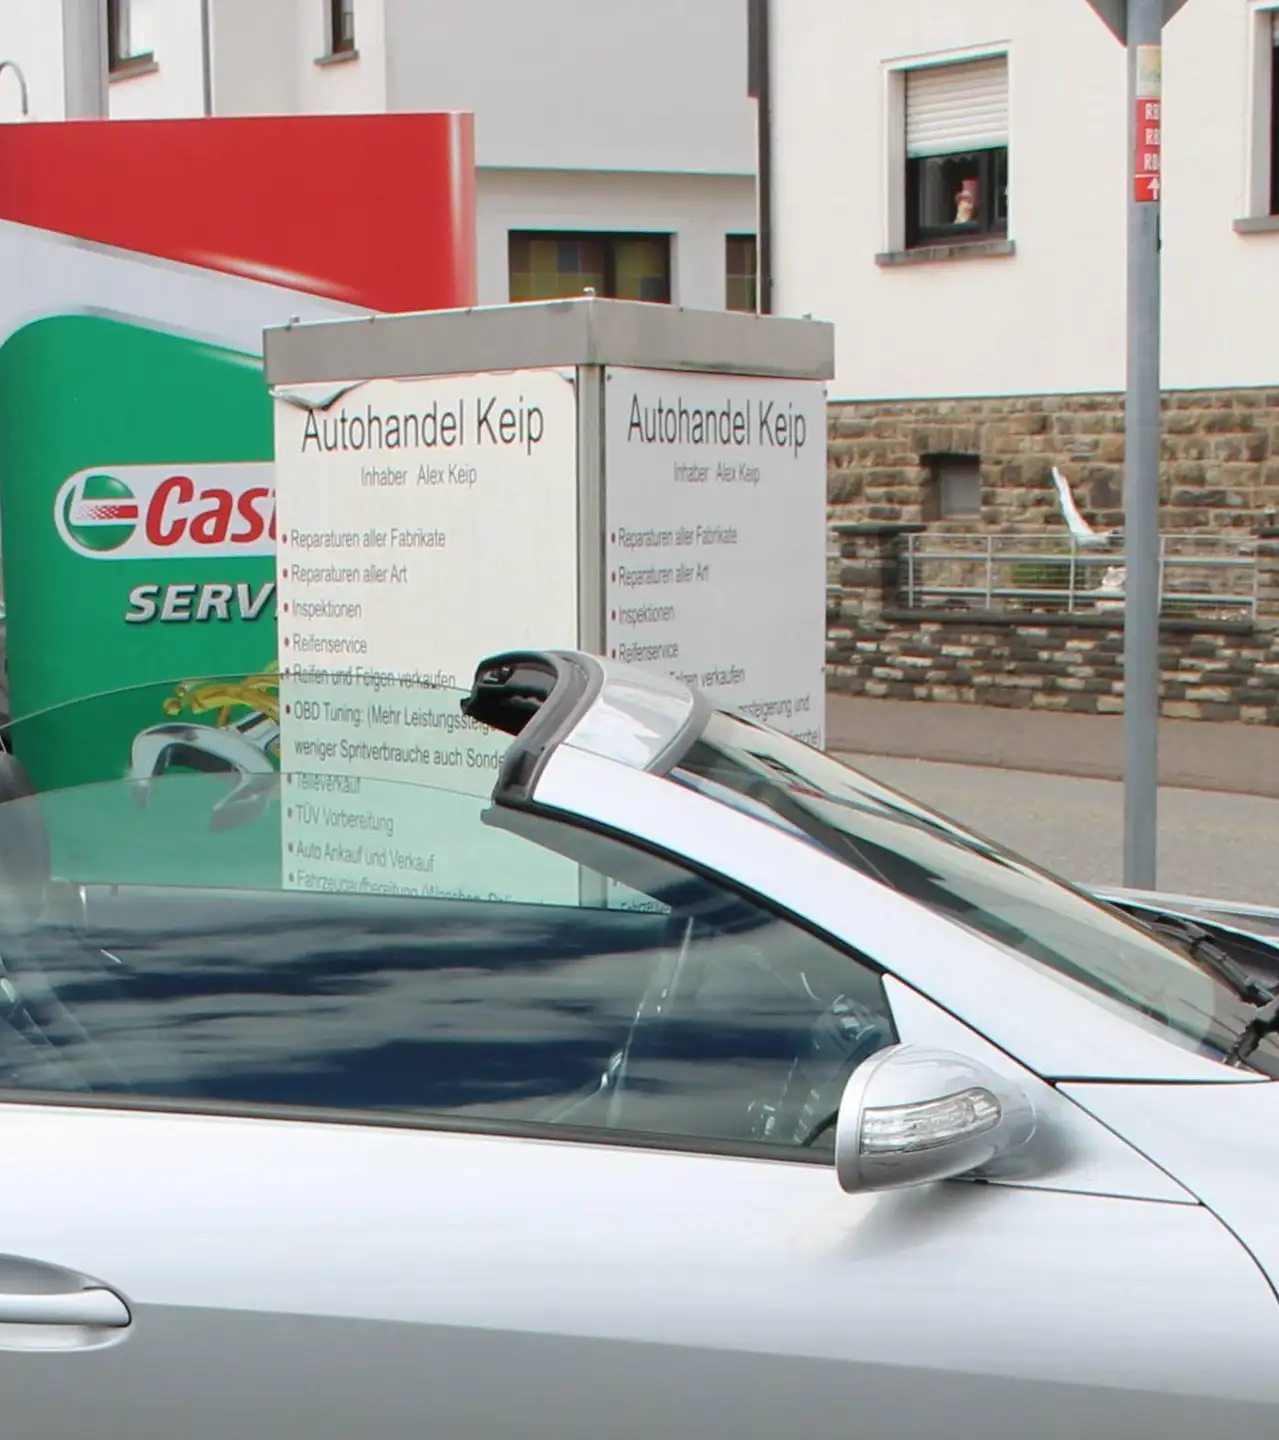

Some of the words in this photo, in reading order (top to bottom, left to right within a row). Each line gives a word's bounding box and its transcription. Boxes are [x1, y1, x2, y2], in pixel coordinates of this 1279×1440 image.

[301, 398, 464, 453] Autohandel
[476, 396, 545, 456] Keip
[627, 393, 751, 446] Autohandel
[759, 399, 807, 459] Keip
[361, 466, 408, 487] Inhaber
[416, 464, 445, 486] Alex
[448, 463, 477, 488] Keip
[674, 461, 709, 483] Inhaber
[716, 461, 736, 483] Alex
[739, 463, 760, 486] Keip
[290, 529, 360, 550] Reparaturen
[363, 528, 387, 548] aller
[391, 527, 446, 547] Fabrikate
[618, 527, 673, 551] Reparaturen
[675, 526, 694, 547] aller
[696, 525, 738, 545] Fabrikate
[290, 564, 360, 585] Reparaturen
[363, 564, 387, 583] aller
[390, 564, 408, 583] Art
[618, 565, 673, 589] Reparaturen
[675, 563, 694, 584] aller
[696, 563, 710, 583] Art
[125, 583, 276, 625] SERV
[292, 600, 362, 621] Inspektionen
[618, 603, 675, 629] Inspektionen
[292, 633, 368, 655] Reifenservice
[619, 642, 679, 664] Reifenservice
[293, 663, 329, 685] Reifen
[331, 666, 353, 686] und
[356, 666, 395, 692] Felgen
[397, 669, 456, 691] verkaufen
[701, 664, 746, 688] verkaufen
[294, 703, 320, 721] OBD
[324, 702, 365, 728] Tuning:
[368, 704, 401, 726] (Mehr
[794, 693, 810, 712] und
[294, 739, 338, 762] weniger
[340, 739, 431, 766] Spritverbrauche
[433, 746, 463, 767] auch
[297, 772, 361, 794] Teileverkauf
[296, 802, 321, 824] TÜV
[323, 807, 394, 837] Vorbereitung
[296, 842, 321, 860] Auto
[324, 843, 362, 864] Ankauf
[366, 848, 387, 868] und
[390, 852, 435, 873] Verkauf
